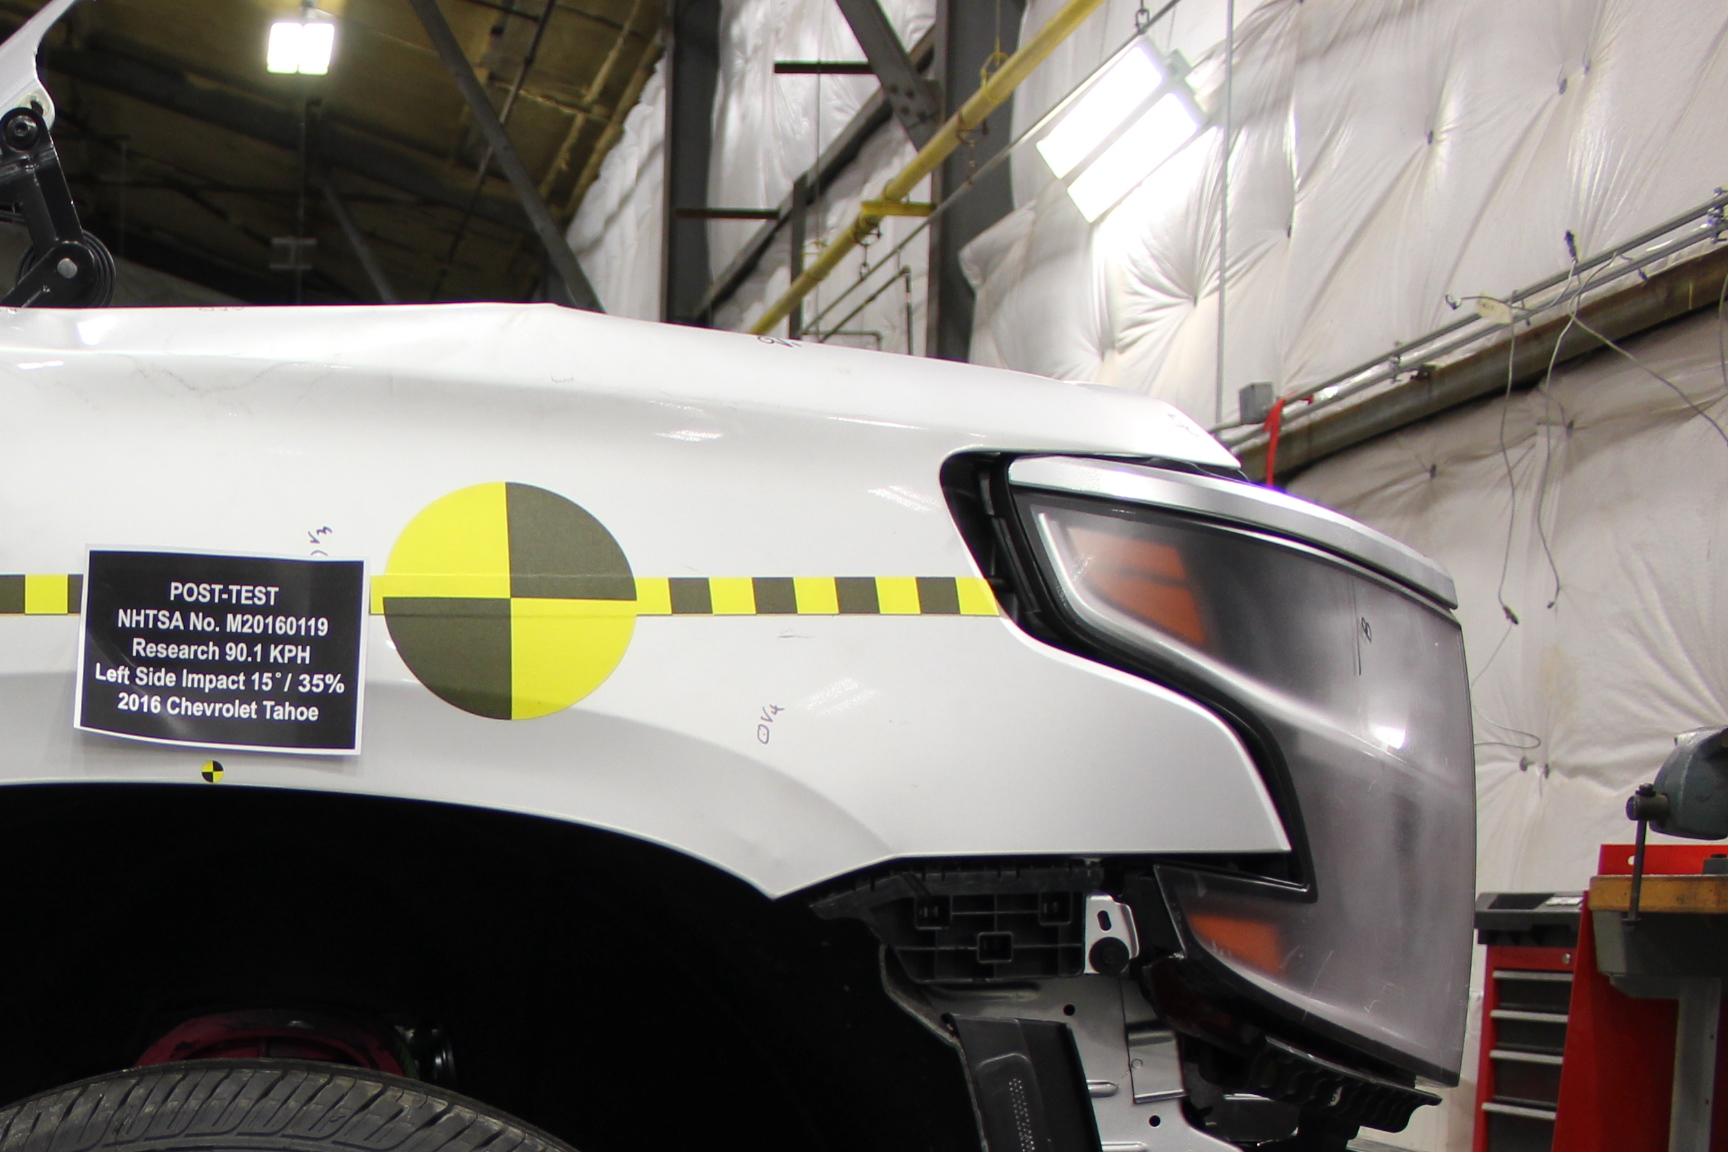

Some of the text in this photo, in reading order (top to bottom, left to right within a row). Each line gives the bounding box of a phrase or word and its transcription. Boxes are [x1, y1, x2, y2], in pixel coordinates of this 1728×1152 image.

[170, 582, 279, 605] POST-TEST
[118, 609, 329, 636] NHTSA No. M20160119
[132, 638, 311, 664] Research 90.1 KPH
[95, 663, 130, 685] Left
[135, 666, 176, 687] Side
[182, 669, 245, 693] Impact
[298, 673, 345, 693] 35%
[118, 692, 319, 721] 2016 Chevrolet Tahoe
